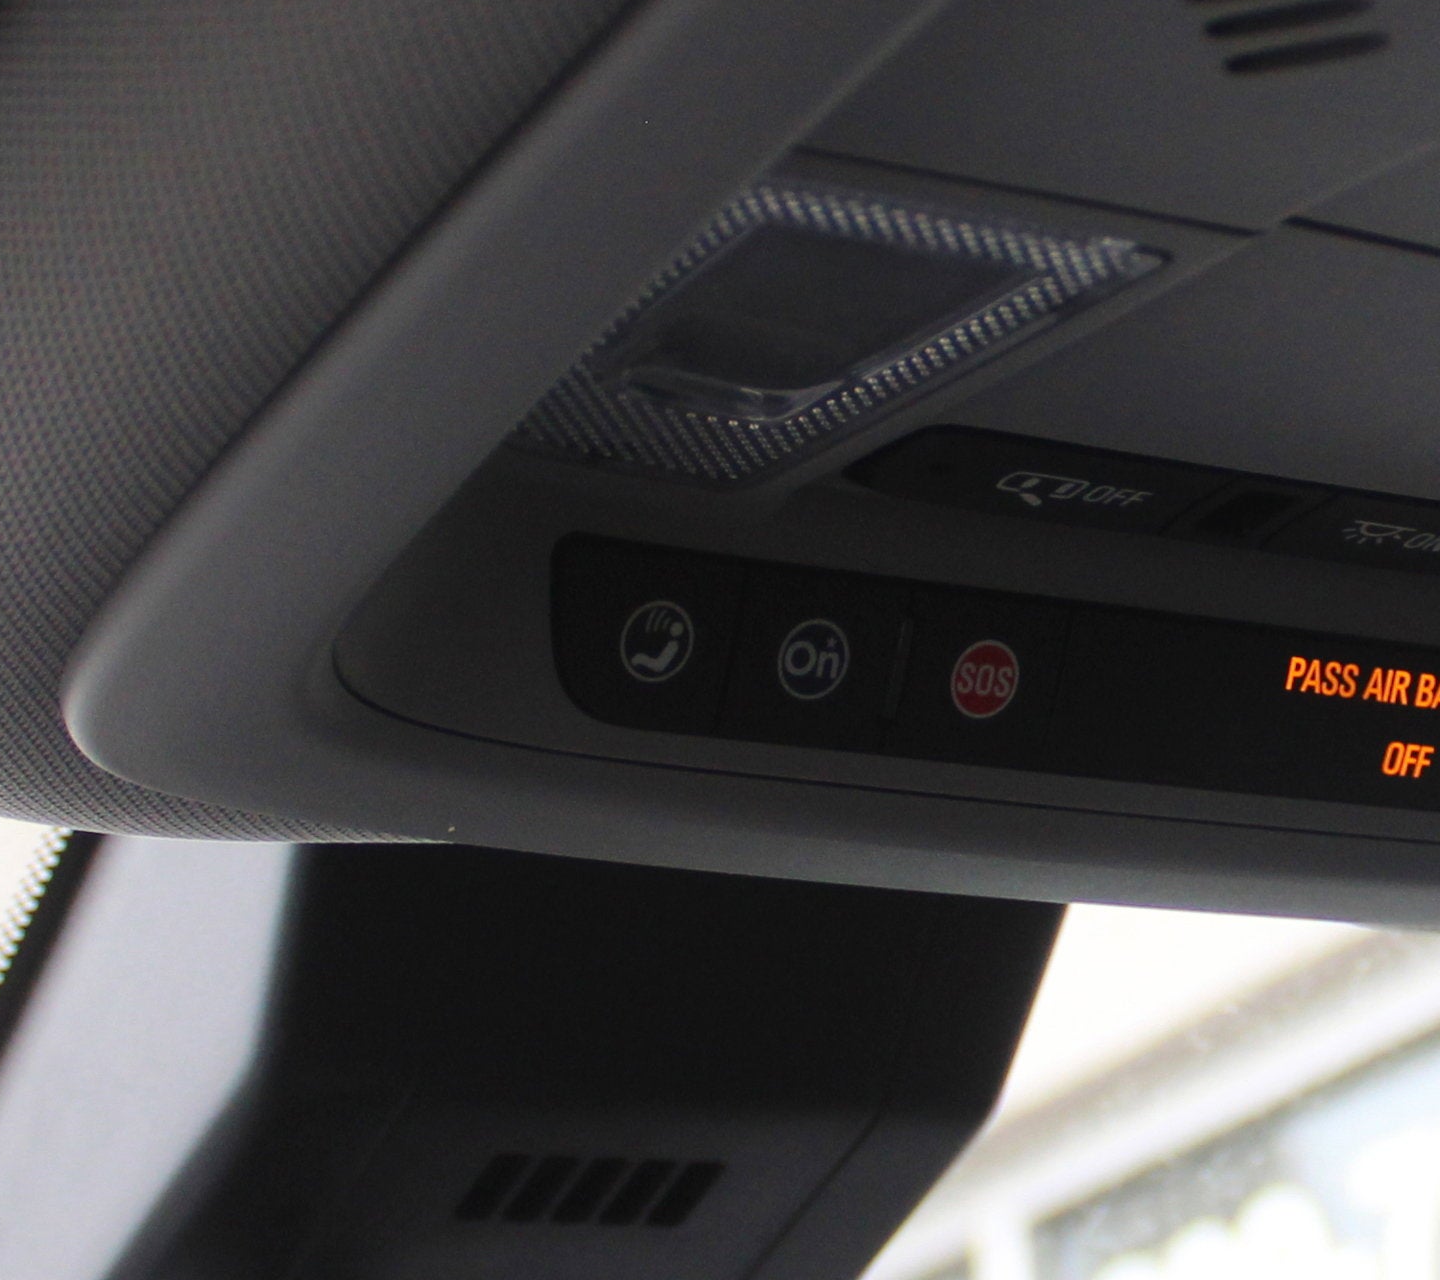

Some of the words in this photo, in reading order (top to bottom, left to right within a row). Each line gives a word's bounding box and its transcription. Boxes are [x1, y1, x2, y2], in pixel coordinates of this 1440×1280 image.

[1082, 485, 1154, 507] OFF
[956, 661, 1014, 698] SOS
[1285, 655, 1360, 699] PASS
[1362, 666, 1412, 707] AIR
[1380, 740, 1436, 780] OFF
